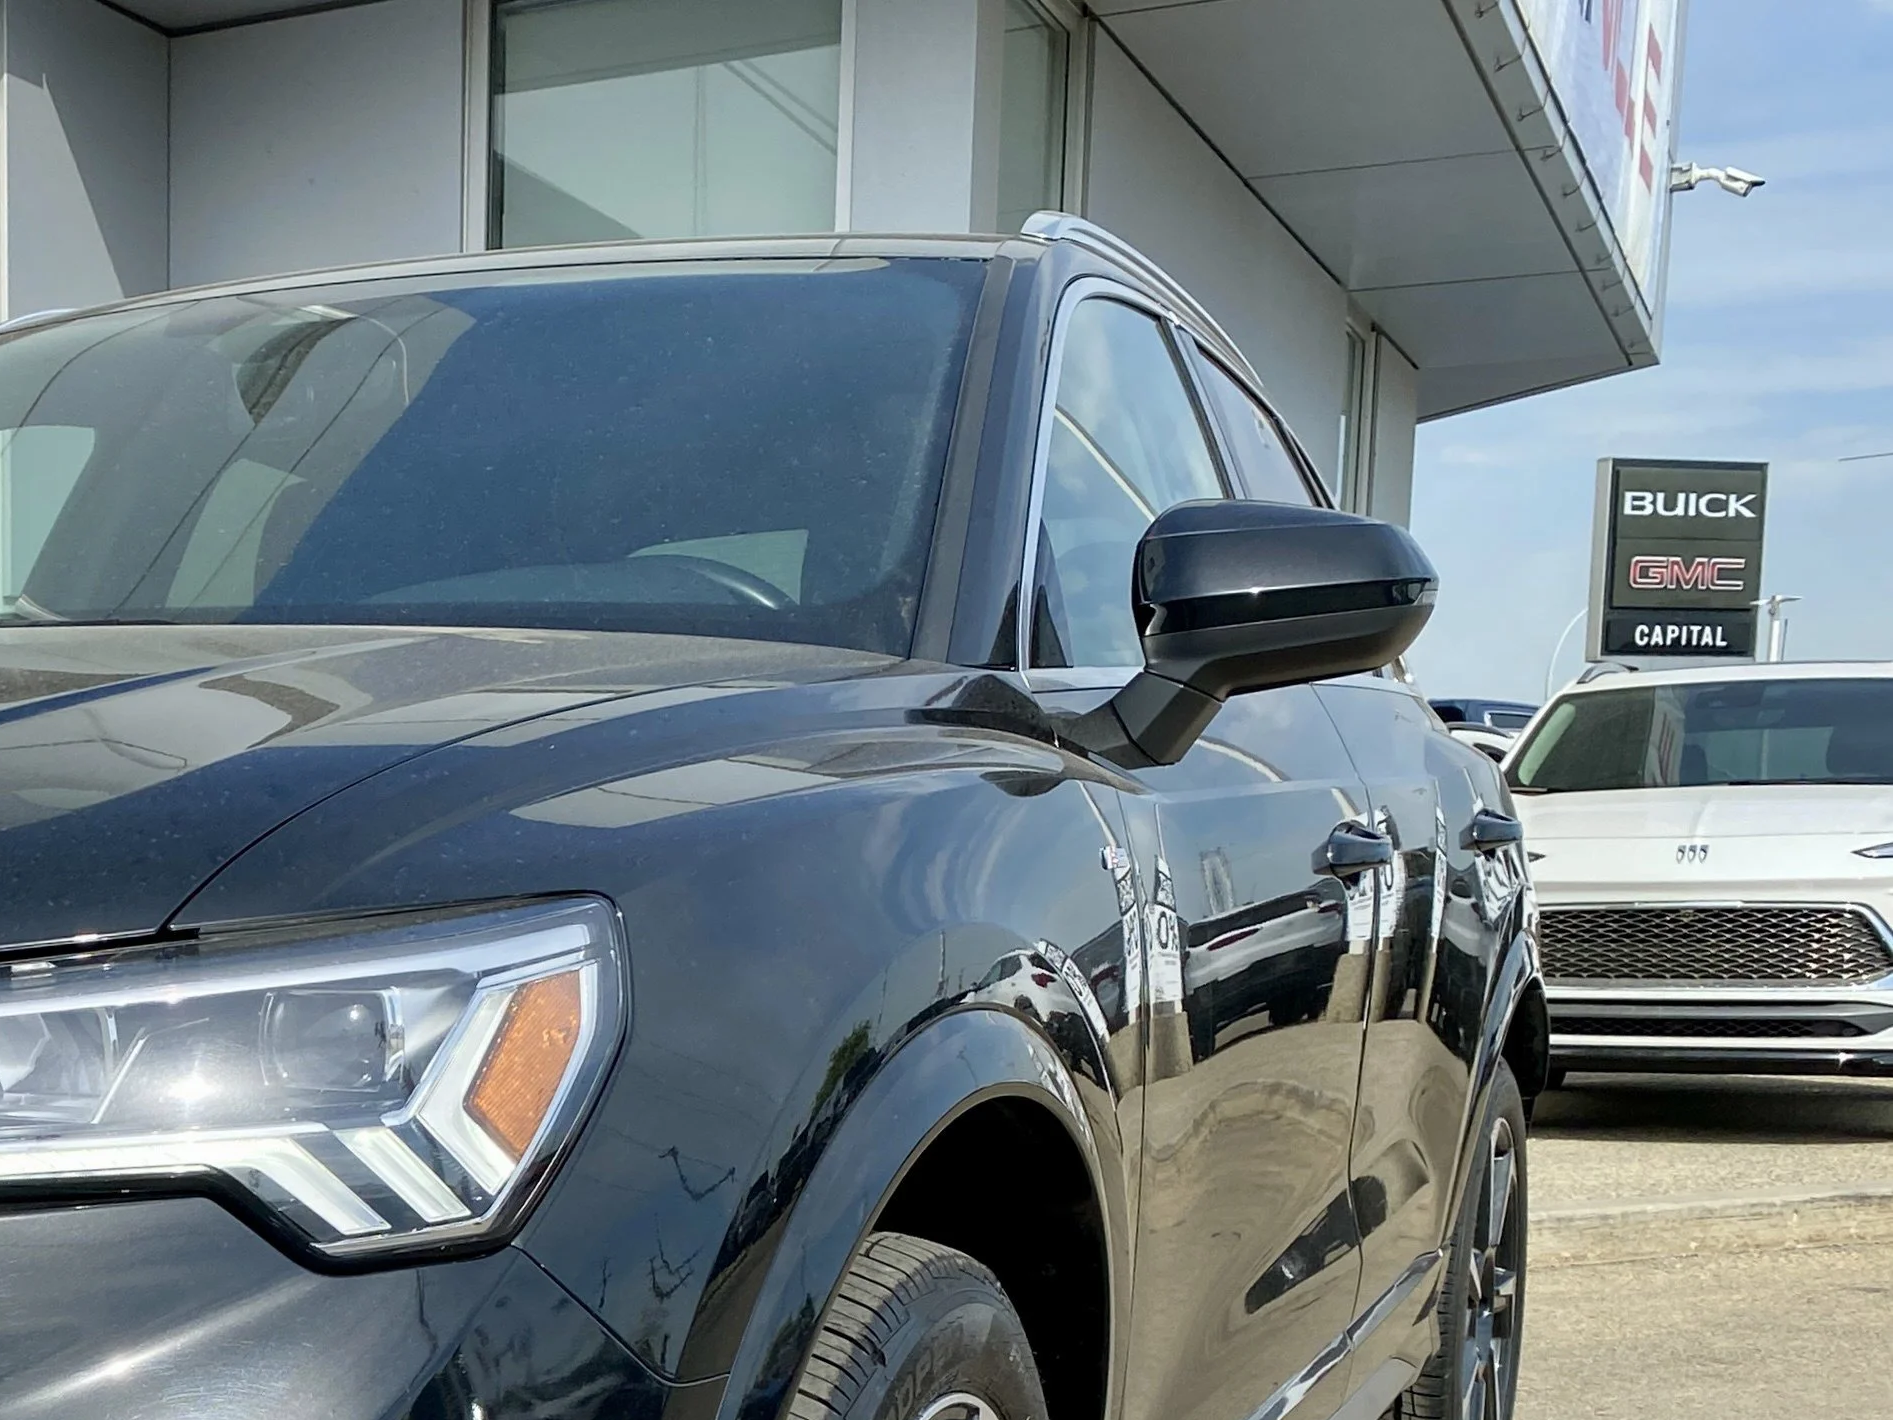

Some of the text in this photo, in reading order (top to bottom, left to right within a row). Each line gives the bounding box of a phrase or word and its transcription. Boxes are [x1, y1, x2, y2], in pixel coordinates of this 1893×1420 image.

[1622, 491, 1758, 518] BUICK
[1629, 555, 1747, 591] GMC
[1634, 624, 1728, 647] CAPITAL
